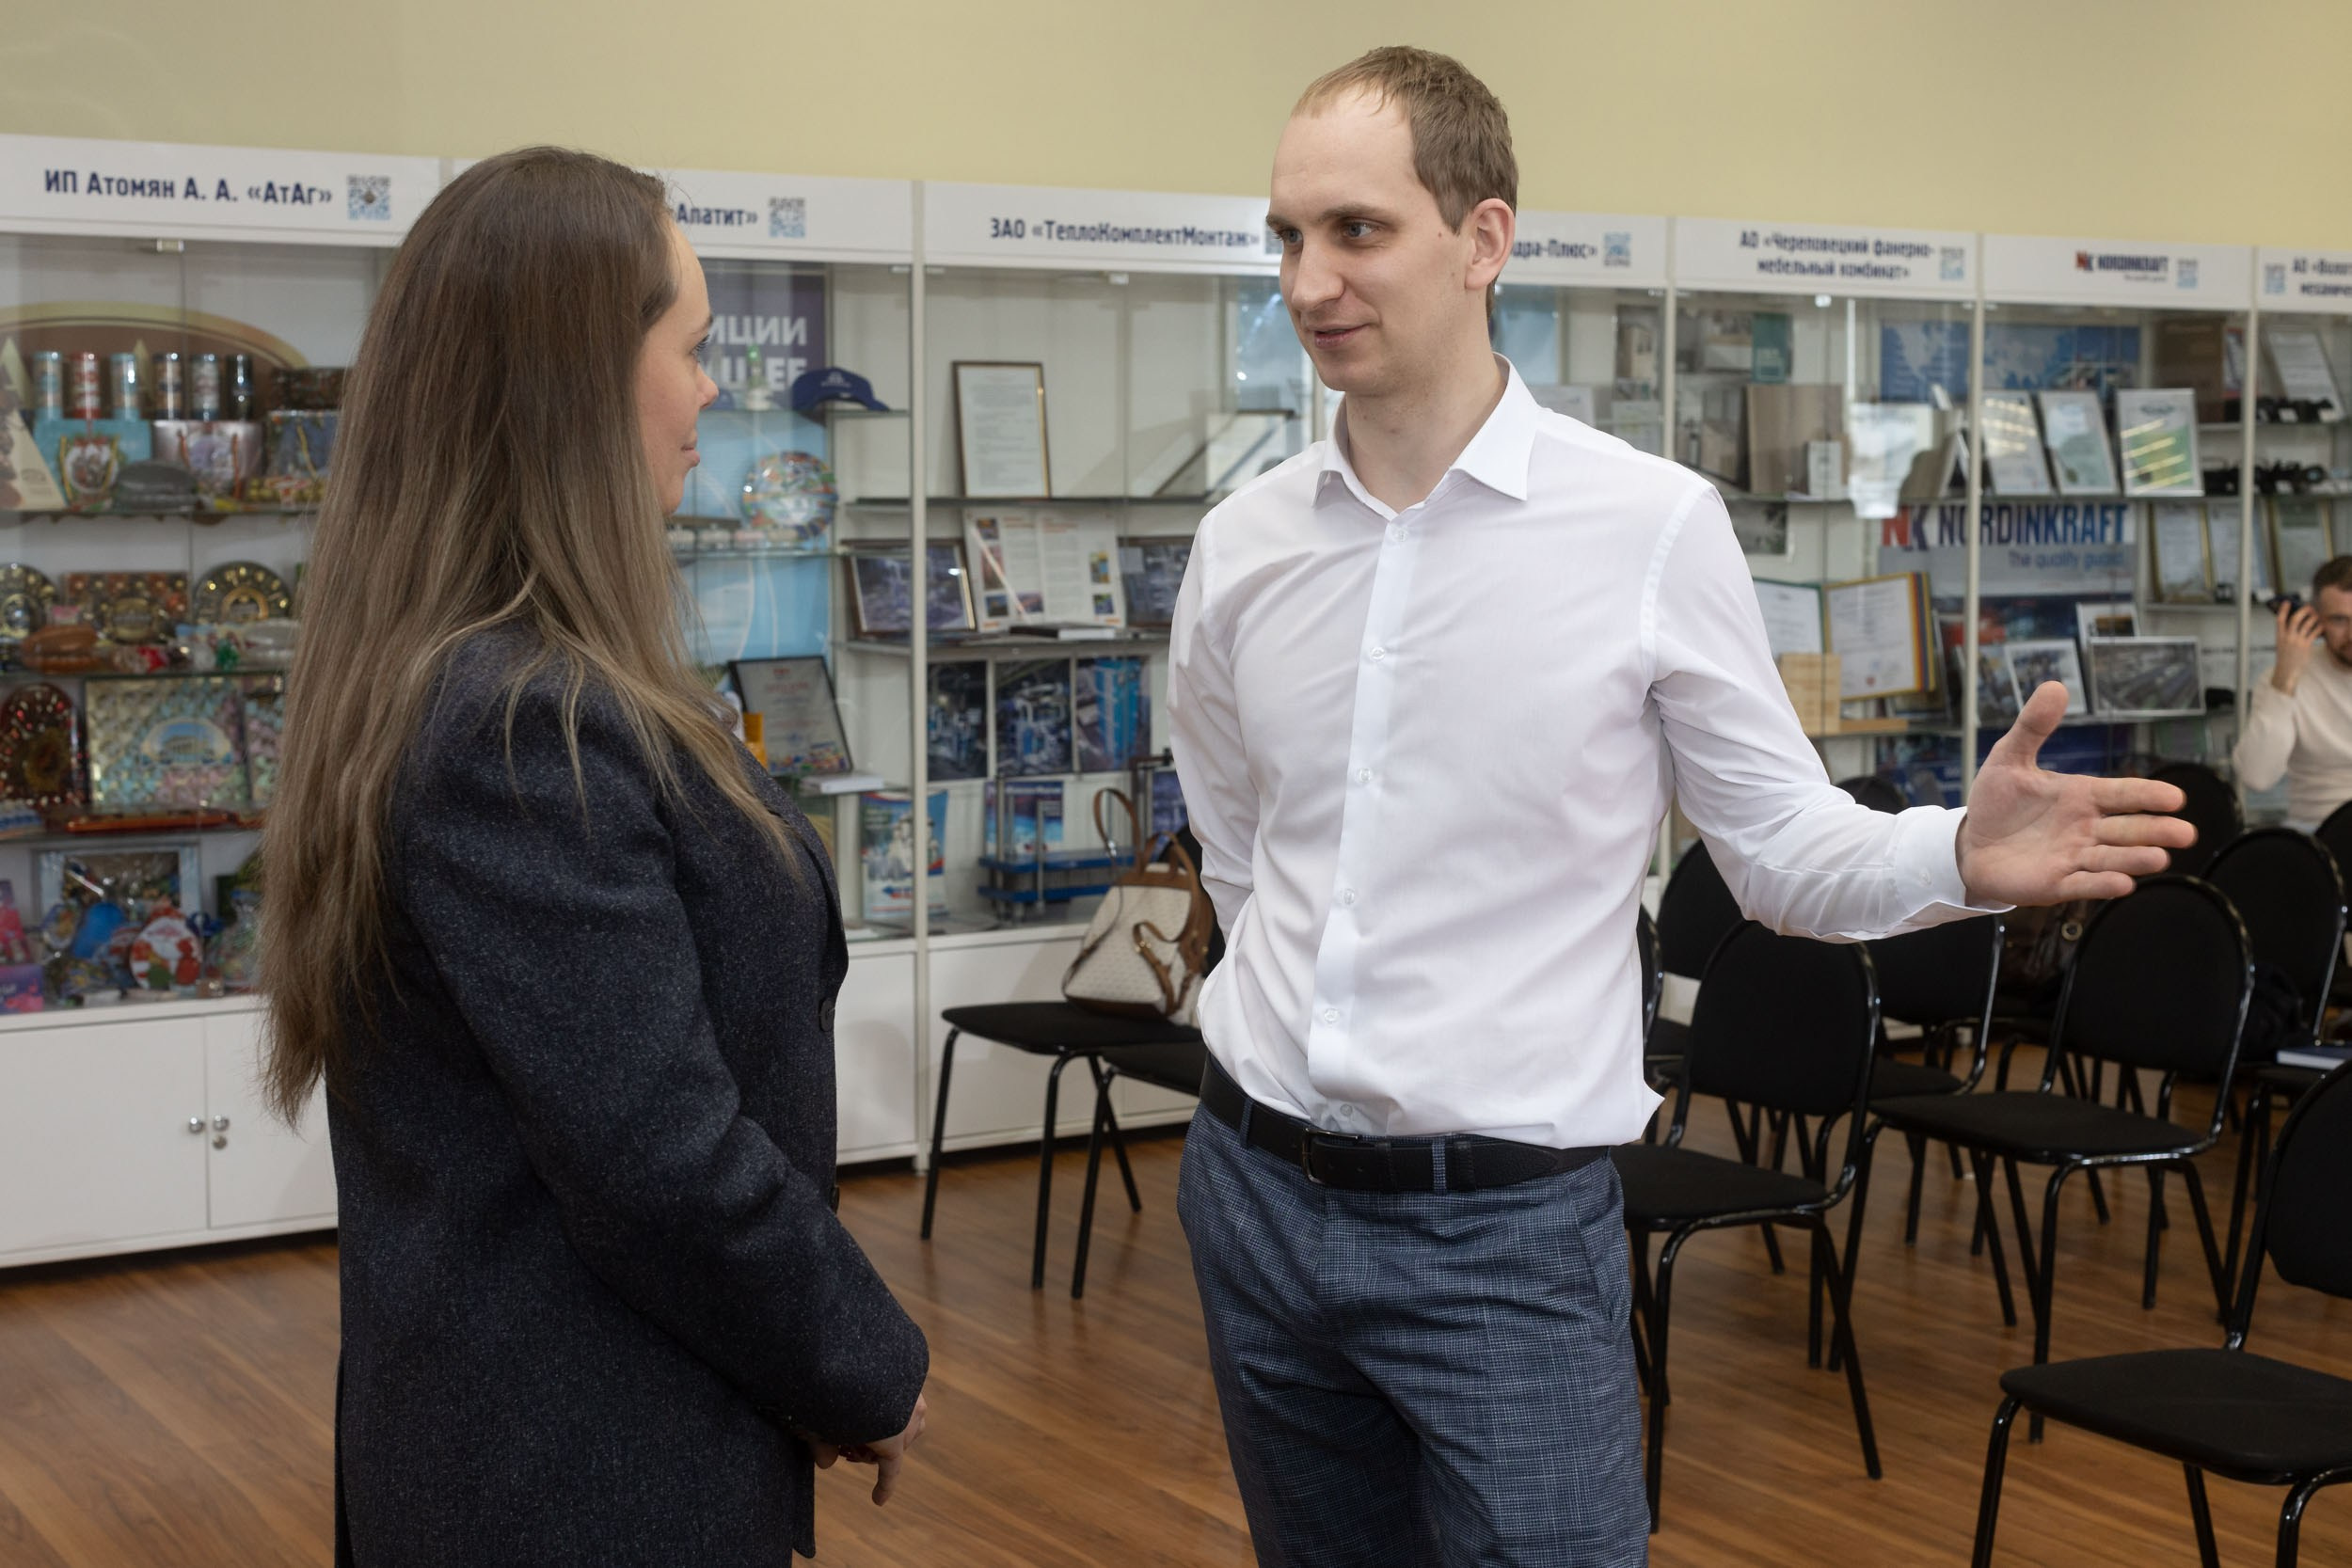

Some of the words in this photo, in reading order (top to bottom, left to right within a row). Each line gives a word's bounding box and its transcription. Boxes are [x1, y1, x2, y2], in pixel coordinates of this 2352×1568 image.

[45, 169, 77, 194] ИП
[87, 171, 175, 198] Атомян
[183, 177, 206, 200] А.
[215, 179, 238, 202] А.
[247, 181, 333, 205] «АтАг»
[990, 217, 1025, 239] ЗАО
[1740, 230, 1759, 248] АО
